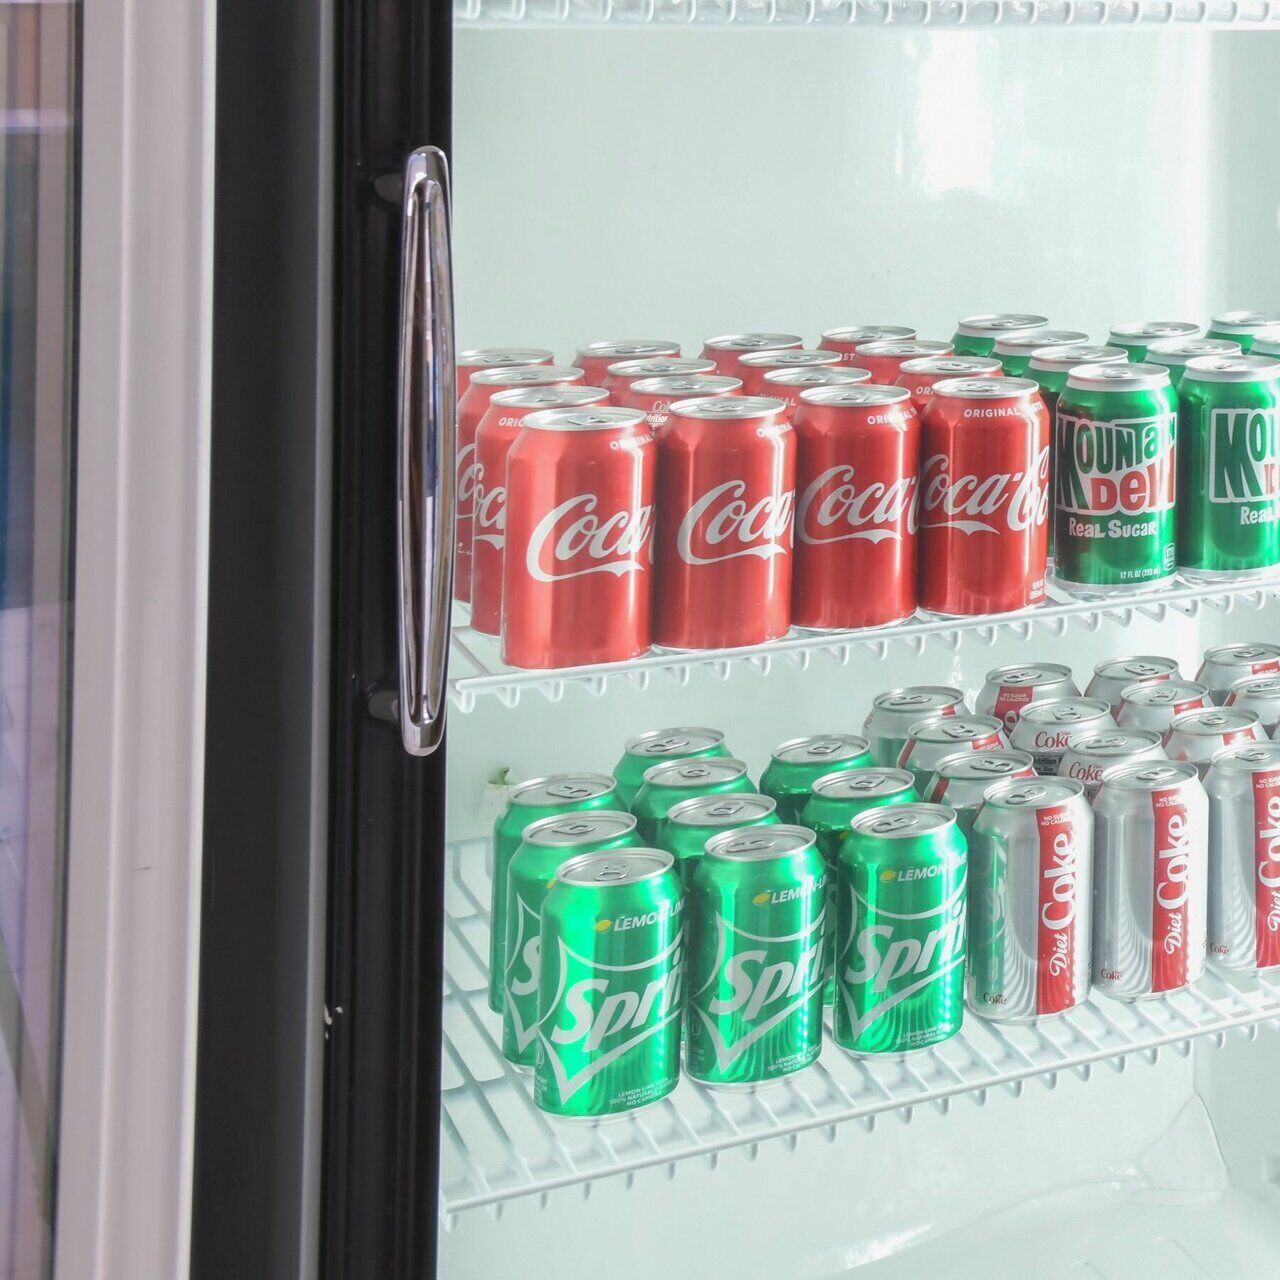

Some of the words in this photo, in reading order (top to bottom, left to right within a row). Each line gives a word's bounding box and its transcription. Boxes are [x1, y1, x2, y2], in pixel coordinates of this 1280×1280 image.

[964, 407, 1021, 419] ORIGINAL
[1041, 832, 1077, 931] Coke
[1156, 813, 1189, 910] Coke
[1049, 933, 1069, 977] Diet
[1164, 911, 1183, 955] Diet
